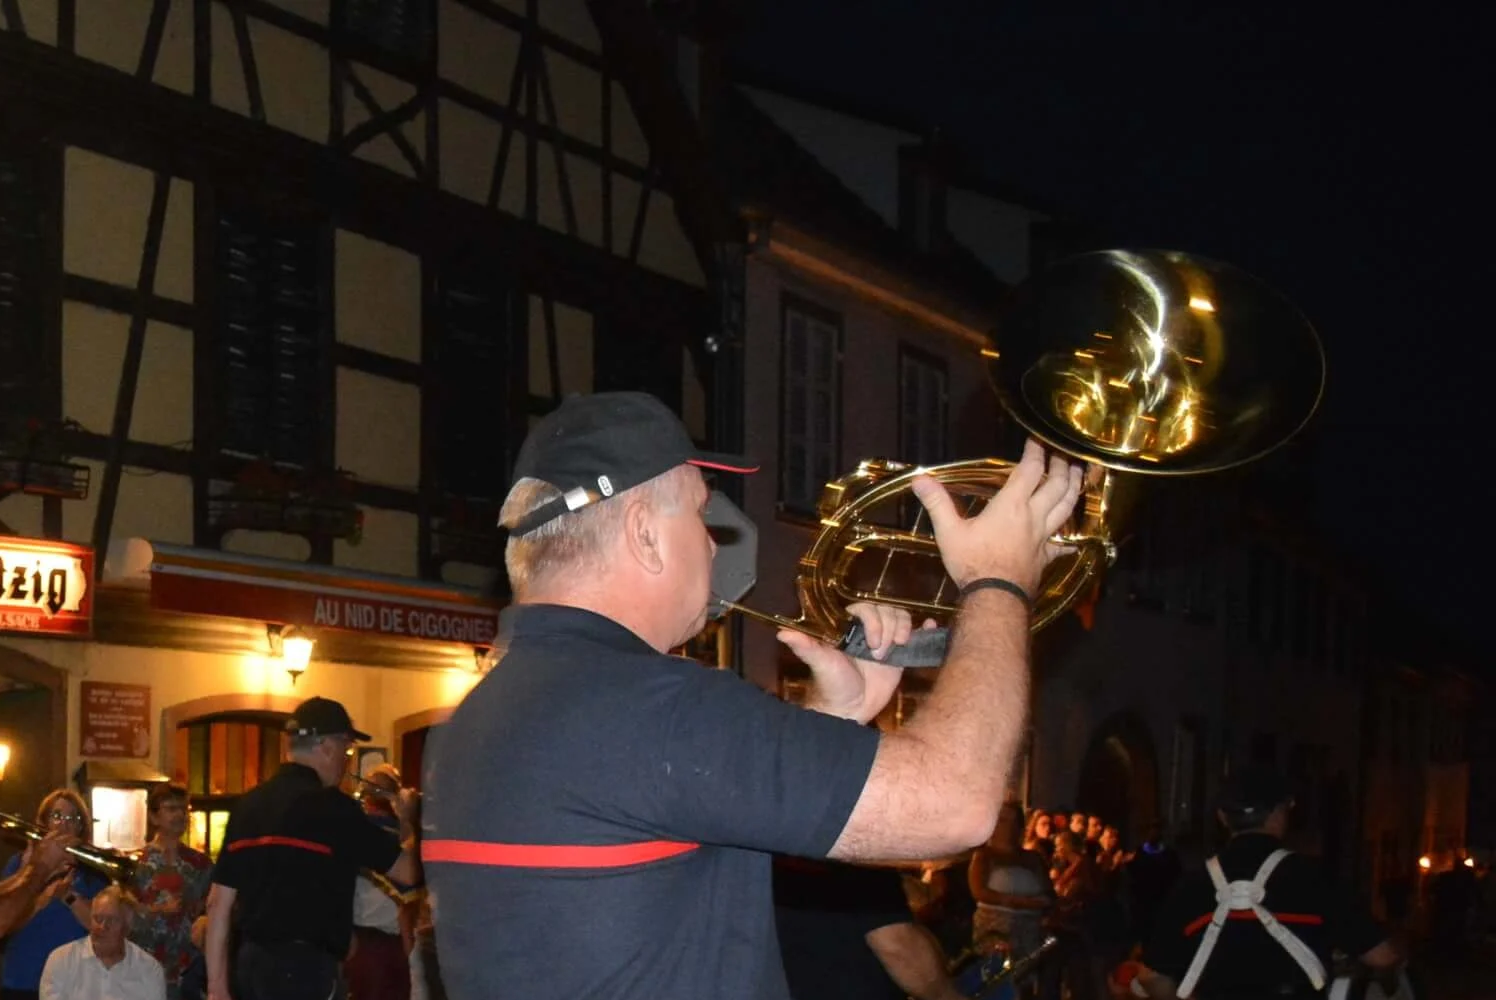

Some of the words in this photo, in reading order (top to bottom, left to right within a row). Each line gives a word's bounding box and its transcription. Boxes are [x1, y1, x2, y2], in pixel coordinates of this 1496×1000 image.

[313, 597, 339, 625] AU
[344, 601, 376, 630] NID
[380, 606, 404, 633] DE
